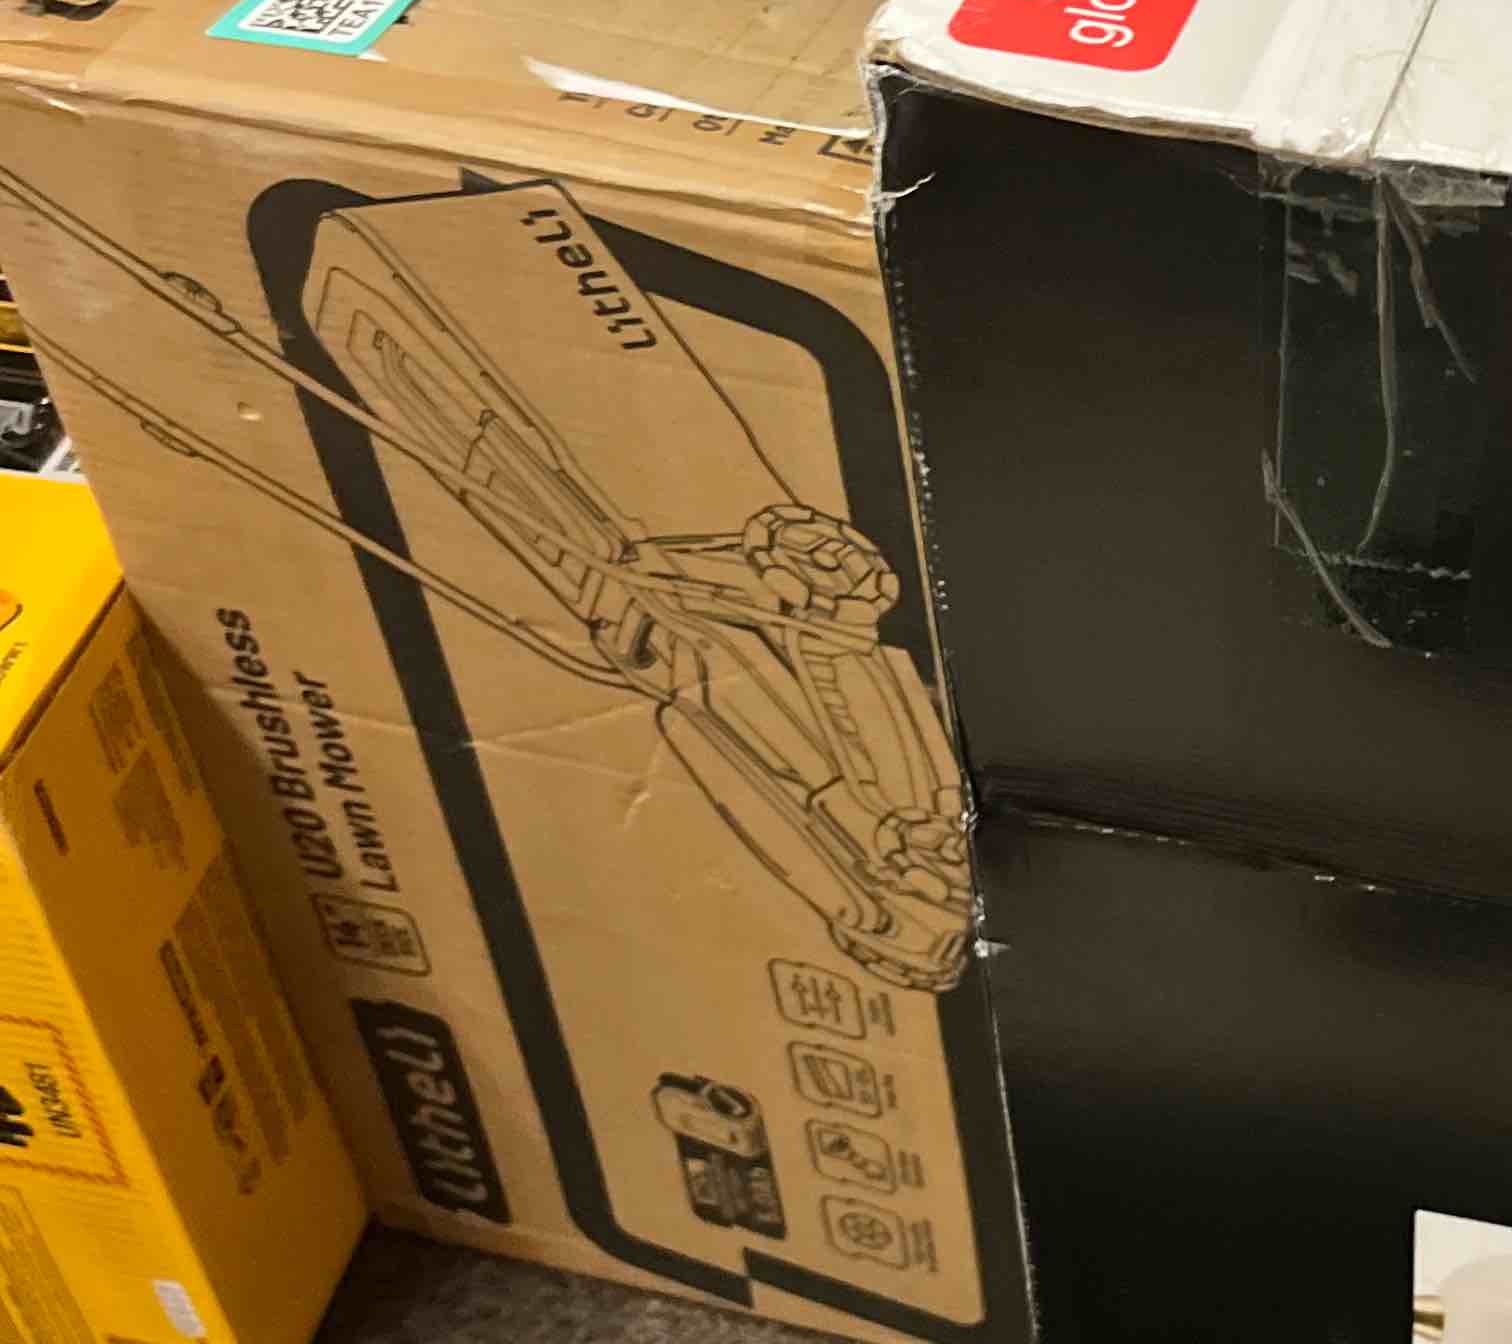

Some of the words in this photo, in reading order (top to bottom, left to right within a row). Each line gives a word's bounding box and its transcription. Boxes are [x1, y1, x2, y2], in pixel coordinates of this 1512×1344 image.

[216, 607, 316, 803] Brushless
[293, 670, 367, 794] Mower
[283, 808, 343, 881] U20
[341, 799, 400, 893] Lawn
